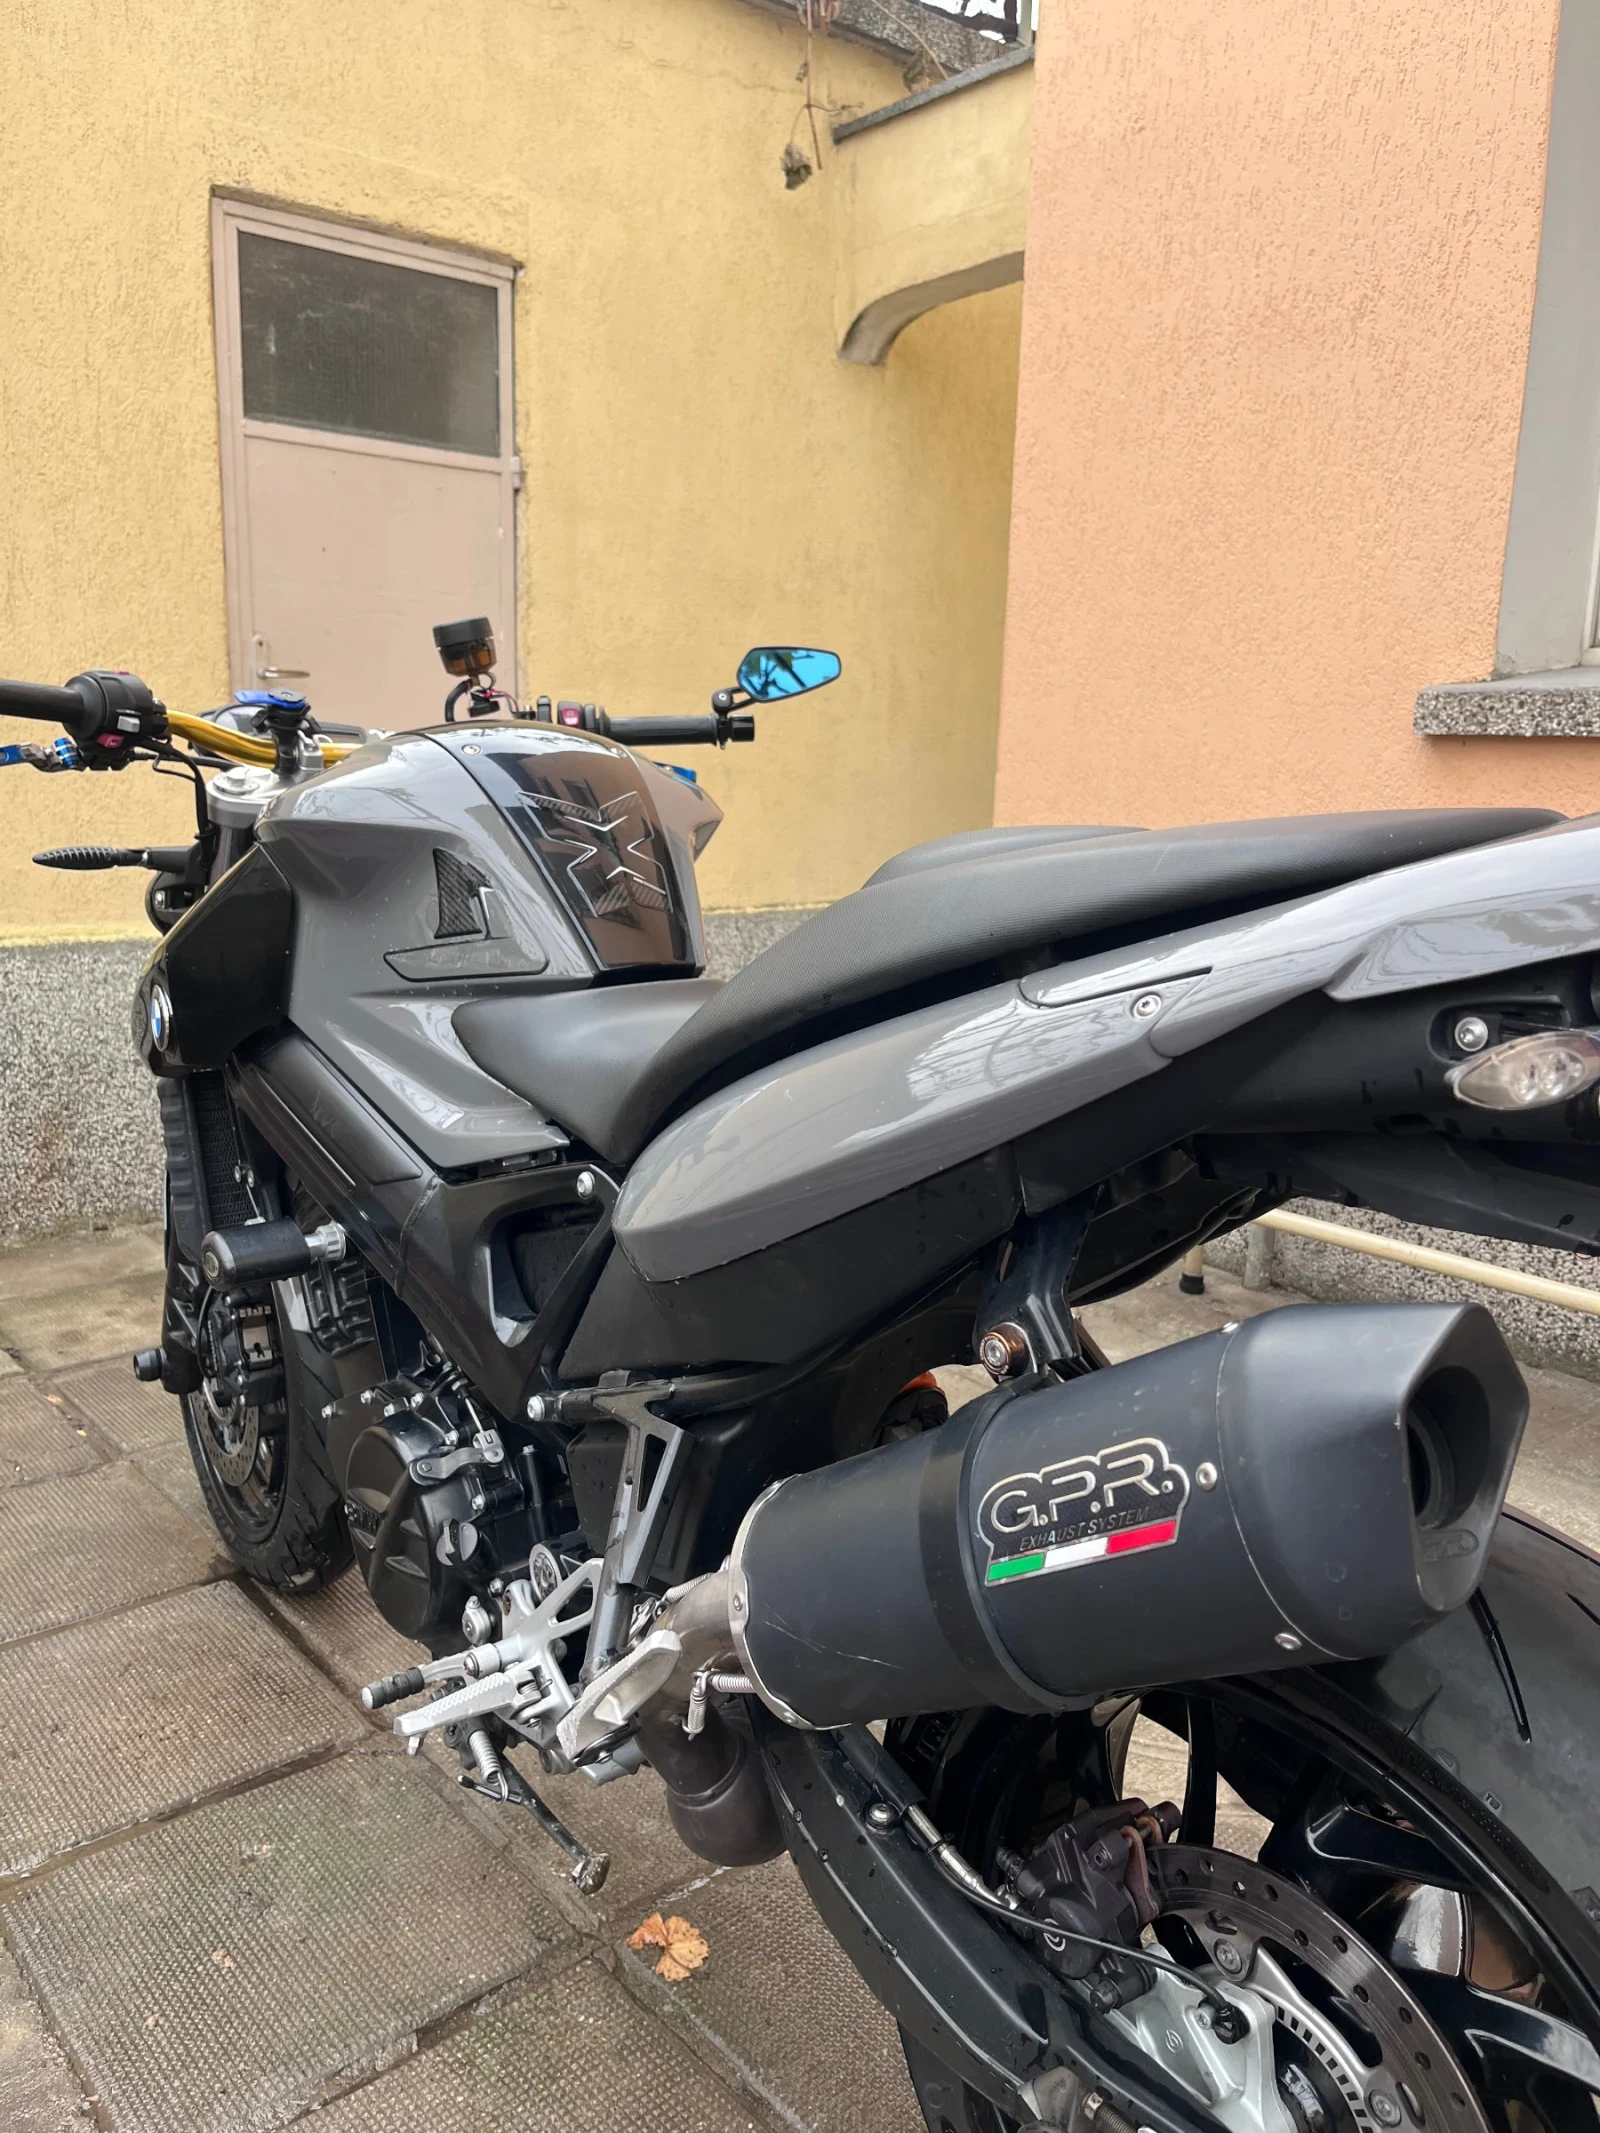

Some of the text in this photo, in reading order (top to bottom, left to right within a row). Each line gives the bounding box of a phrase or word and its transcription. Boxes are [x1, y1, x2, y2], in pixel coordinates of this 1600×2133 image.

[990, 1453, 1174, 1533] G.P.R.
[1019, 1506, 1150, 1551] EXHAUST SYSTEM
